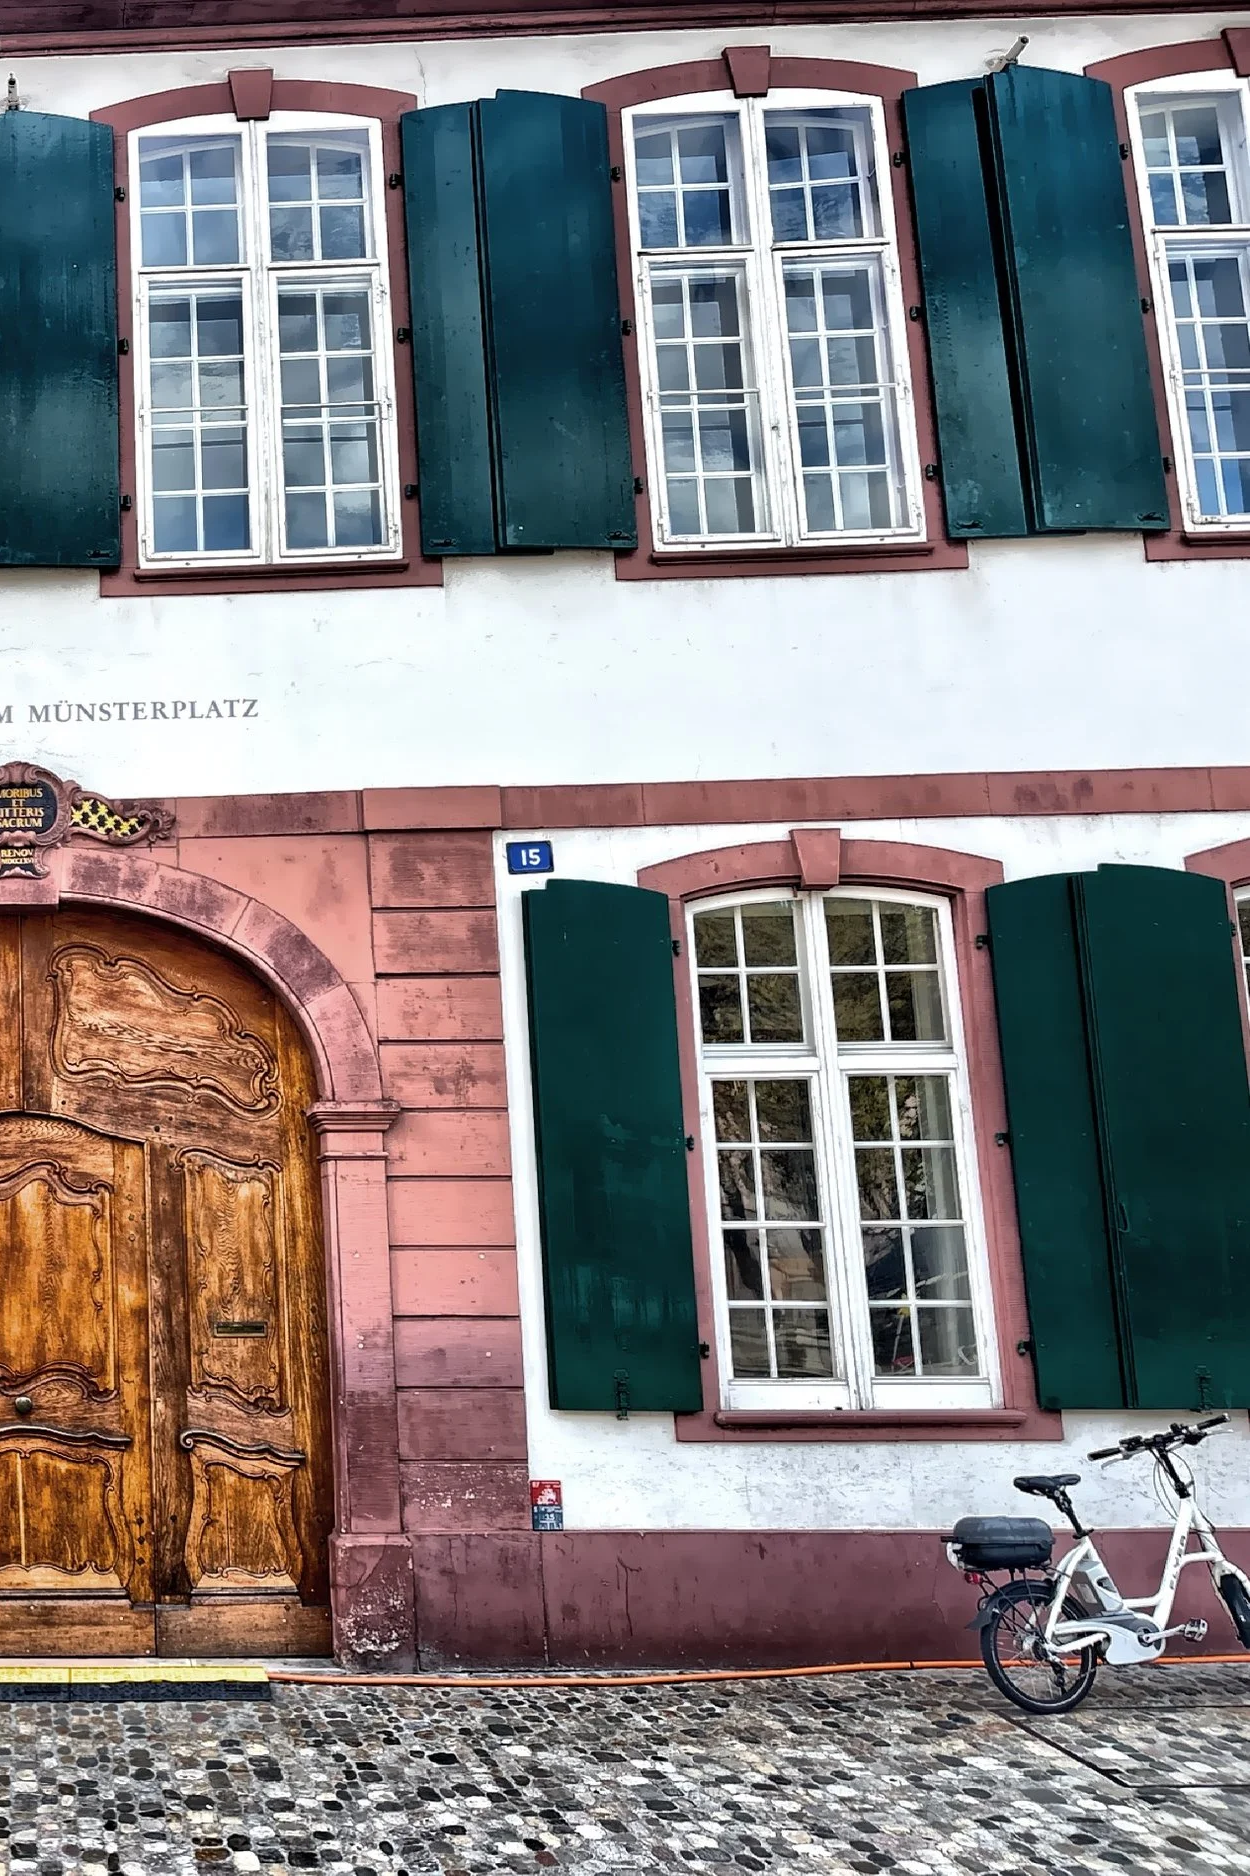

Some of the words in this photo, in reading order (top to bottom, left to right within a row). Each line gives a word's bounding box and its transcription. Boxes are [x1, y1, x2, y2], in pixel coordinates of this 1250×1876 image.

[27, 698, 260, 723] MÜNSTERPLATZ
[11, 798, 26, 808] ET
[521, 848, 541, 866] 15
